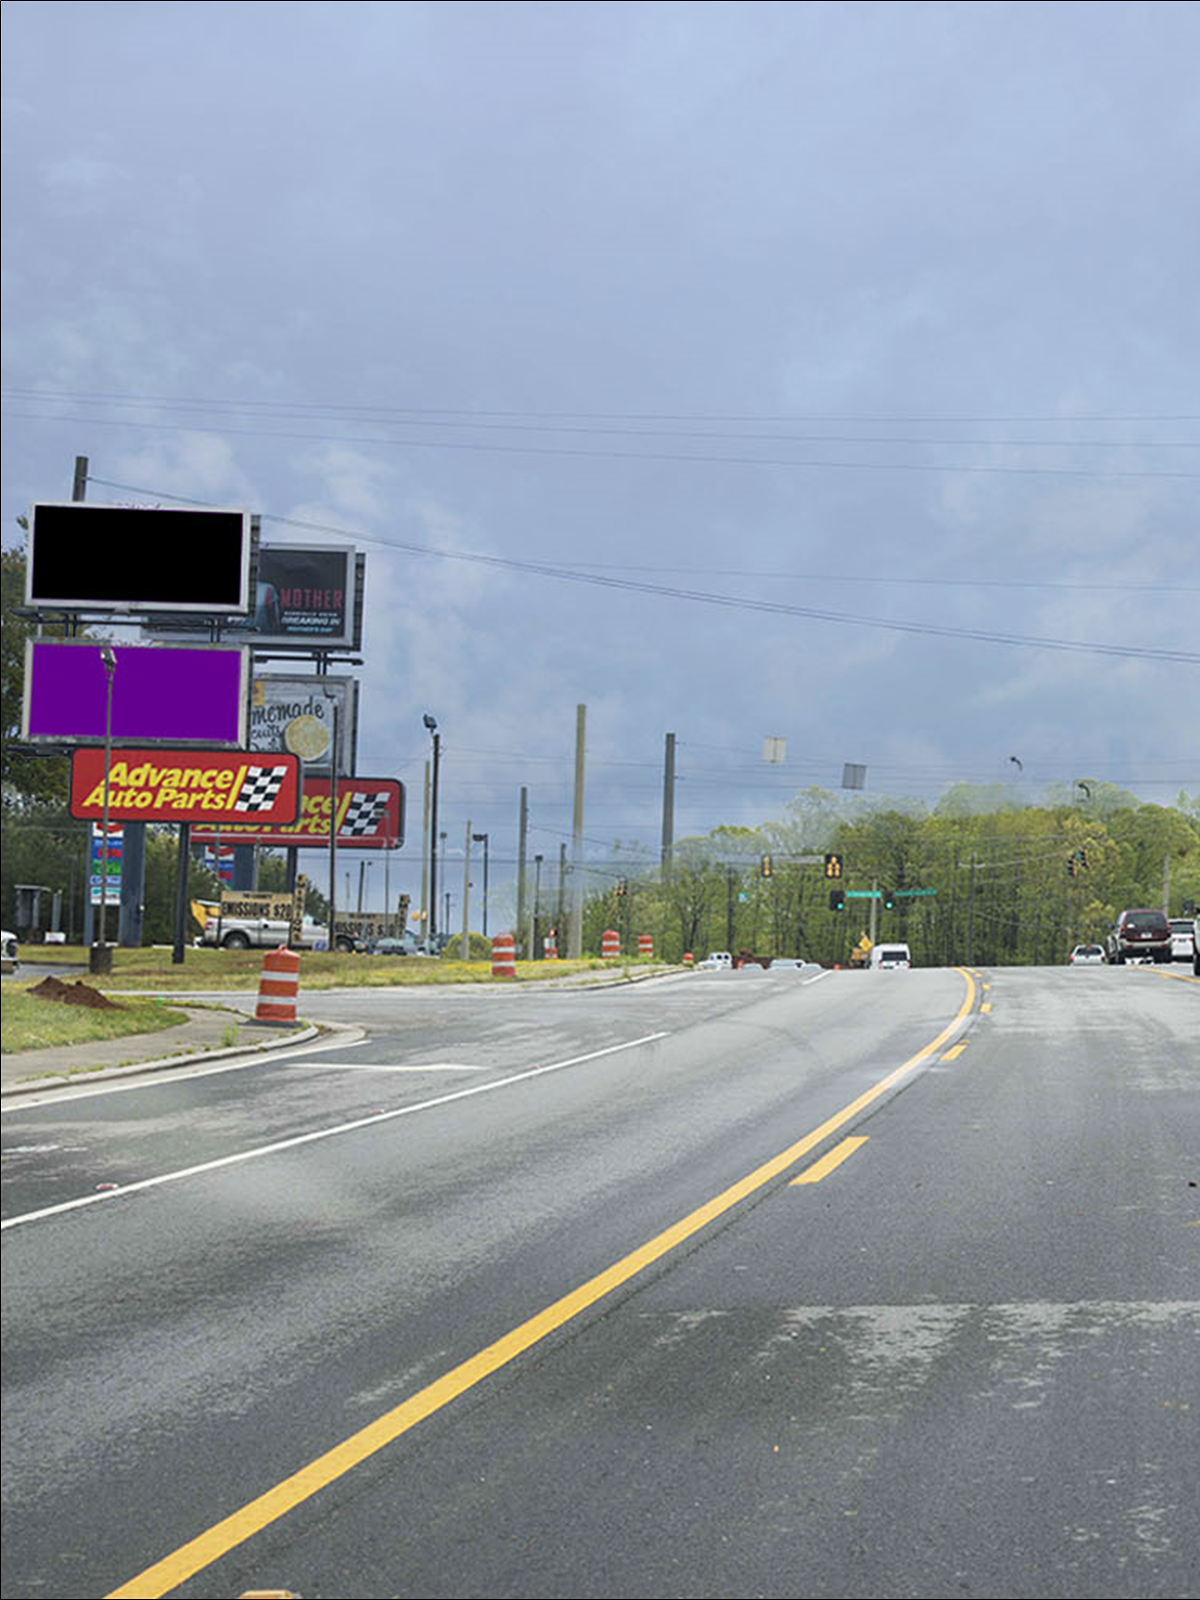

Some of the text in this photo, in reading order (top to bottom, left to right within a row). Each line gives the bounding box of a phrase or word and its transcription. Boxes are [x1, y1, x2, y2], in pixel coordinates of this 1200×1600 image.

[280, 588, 343, 608] MOTHER
[251, 695, 325, 726] memade
[101, 762, 234, 789] Advance
[82, 784, 227, 810] Auto Parts
[220, 902, 271, 917] EMISSIONS
